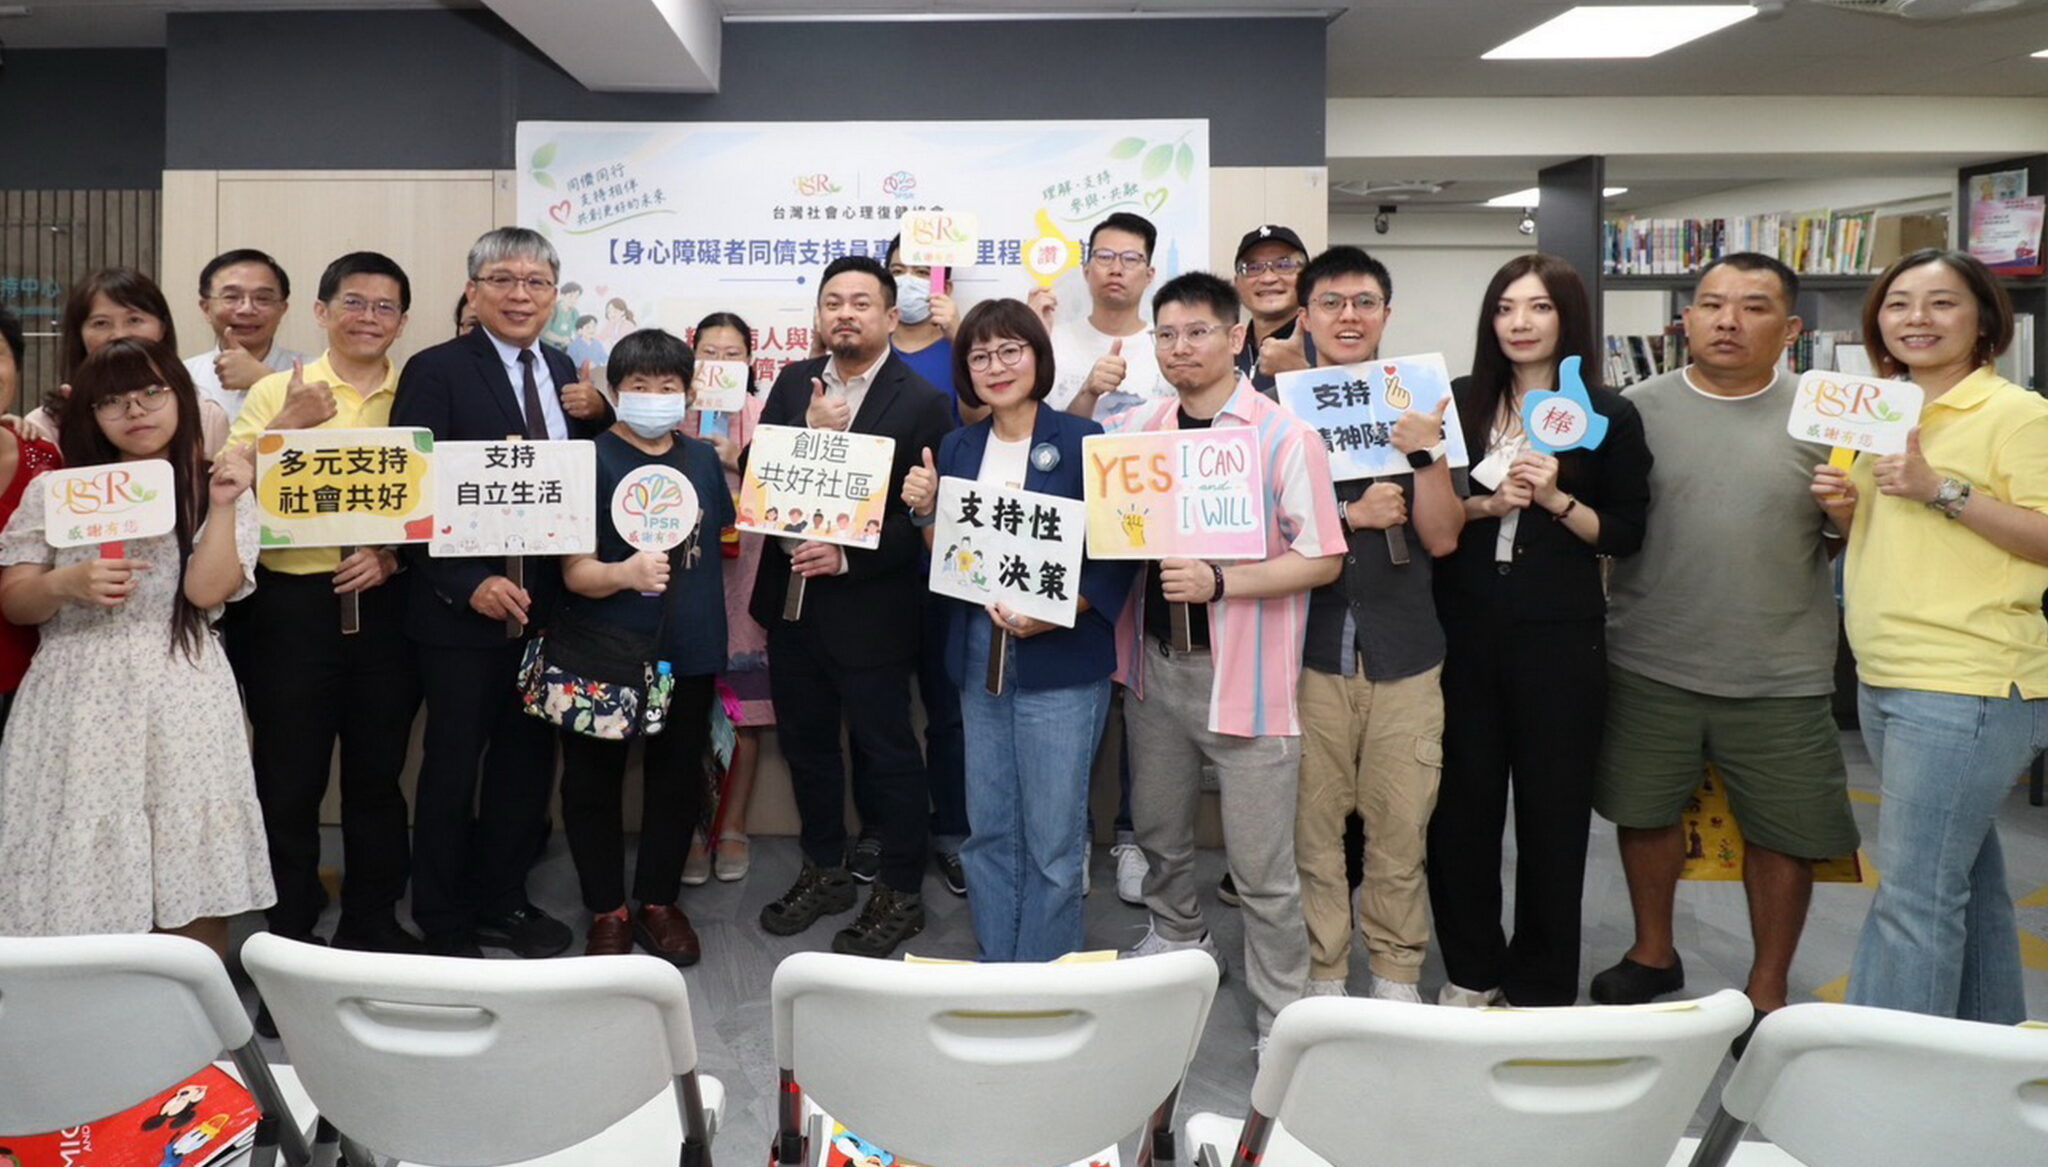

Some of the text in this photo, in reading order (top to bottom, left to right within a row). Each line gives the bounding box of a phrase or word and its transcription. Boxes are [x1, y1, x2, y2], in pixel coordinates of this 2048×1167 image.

[773, 205, 944, 220] 台灣社會心理復健
[1313, 379, 1370, 410] 支持
[1542, 405, 1576, 435] 棒
[279, 446, 409, 478] 多元支持
[484, 444, 536, 470] 支持
[791, 431, 850, 464] 創造
[1181, 443, 1246, 478] I CAN
[757, 461, 873, 501] 共好社區
[1092, 452, 1174, 499] YES
[278, 483, 409, 515] 社會共好
[457, 479, 563, 507] 自立生活
[649, 516, 681, 529] PSR
[956, 490, 1063, 543] 支持性
[1182, 496, 1253, 529] I WILL
[998, 554, 1069, 601] 決策
[82, 1125, 93, 1152] AND
